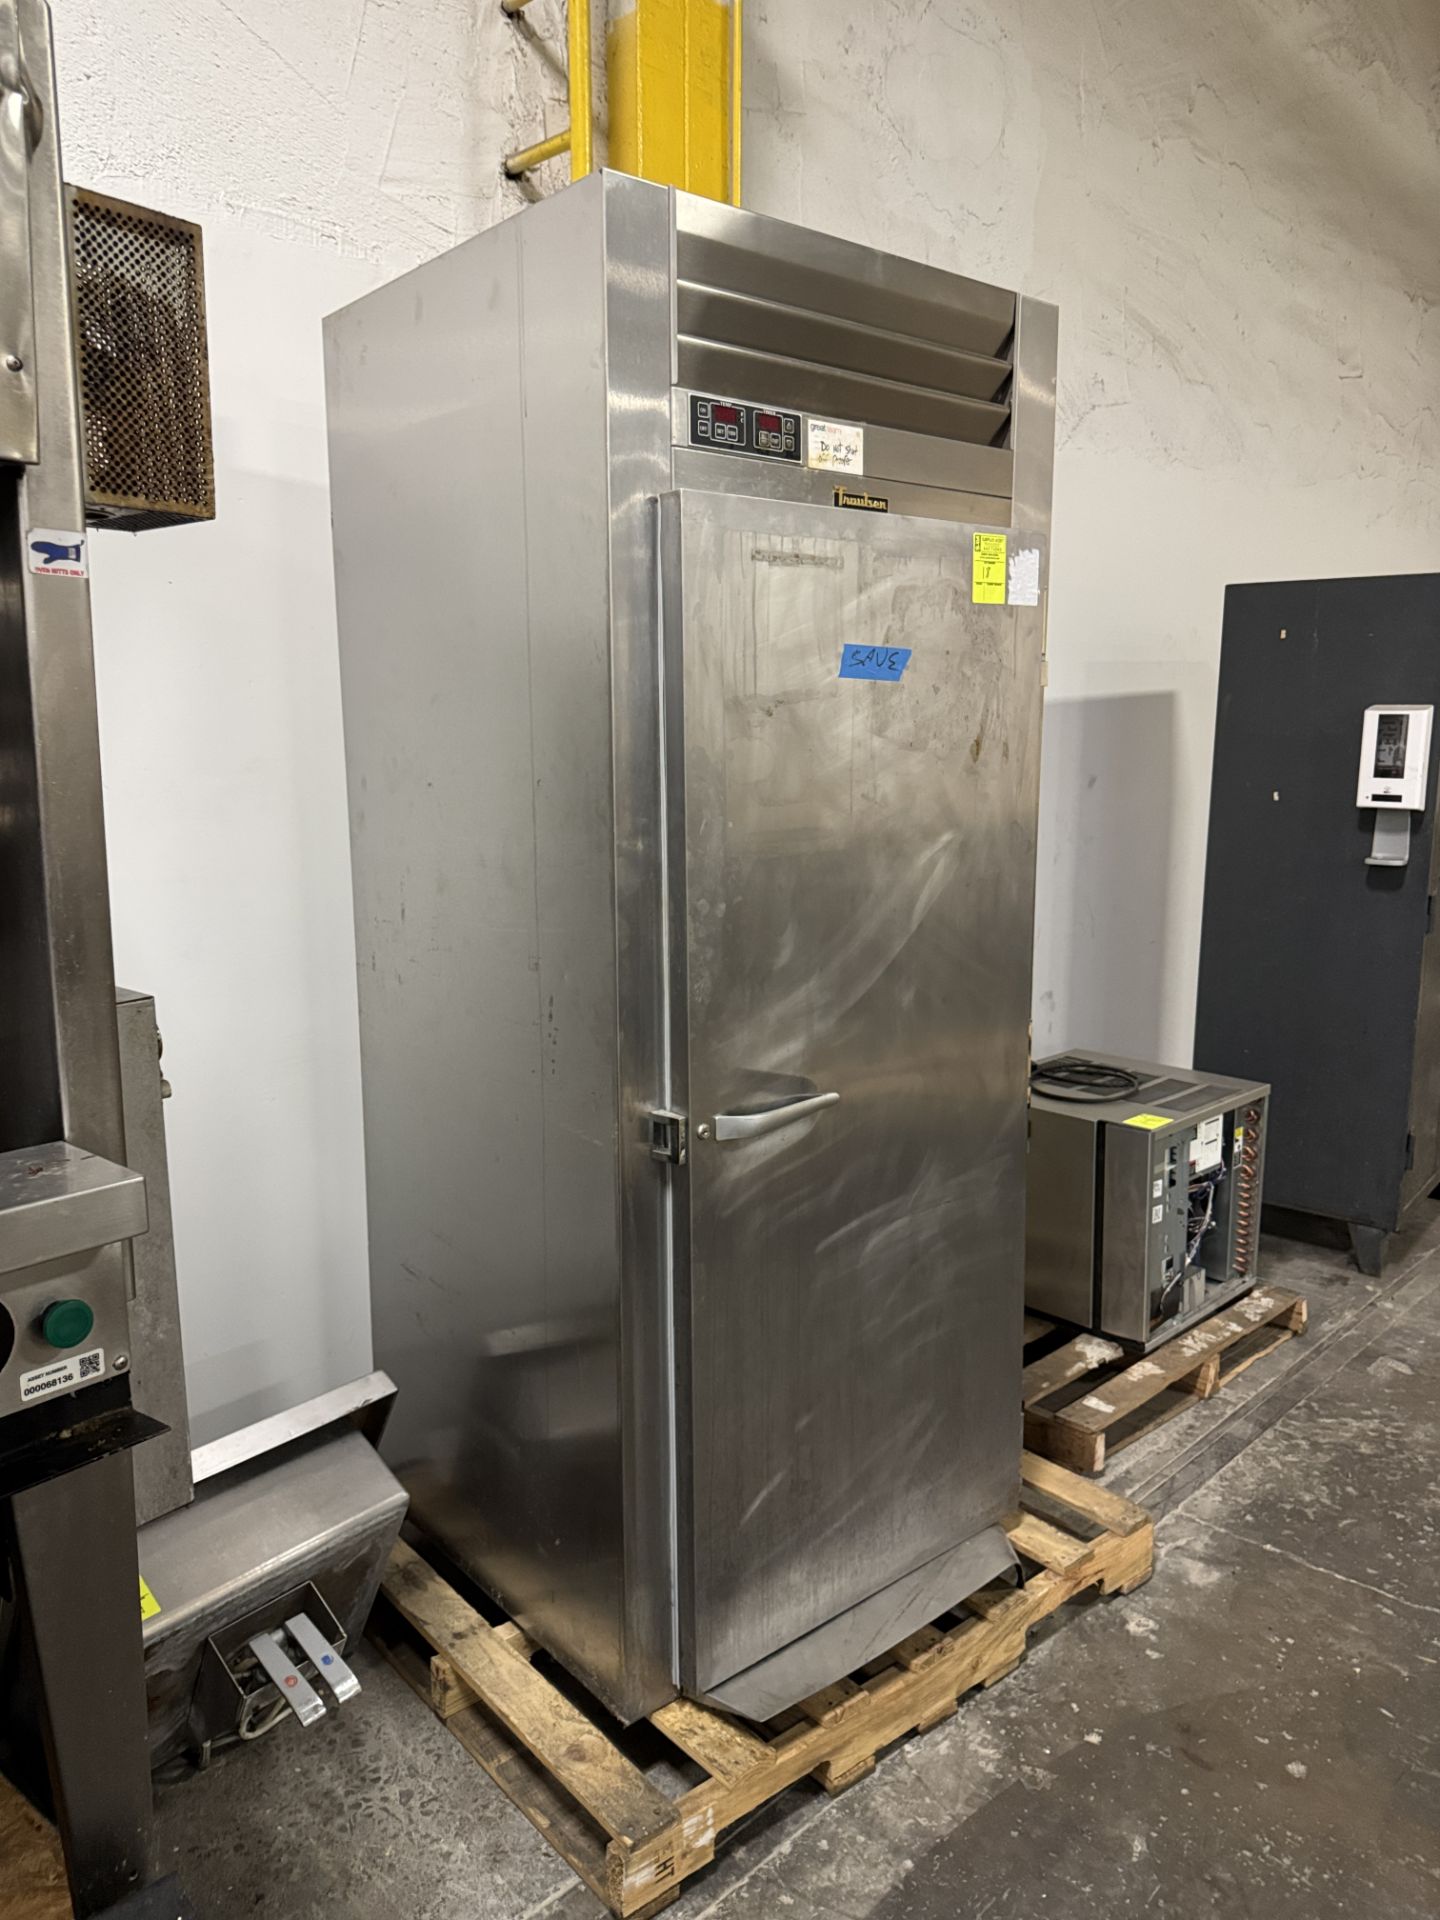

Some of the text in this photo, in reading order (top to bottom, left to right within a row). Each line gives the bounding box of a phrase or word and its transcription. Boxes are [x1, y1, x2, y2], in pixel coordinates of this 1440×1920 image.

[848, 647, 901, 672] SAVE
[24, 1373, 74, 1396] 000068136
[28, 1365, 67, 1382] ASSET NUMBER
